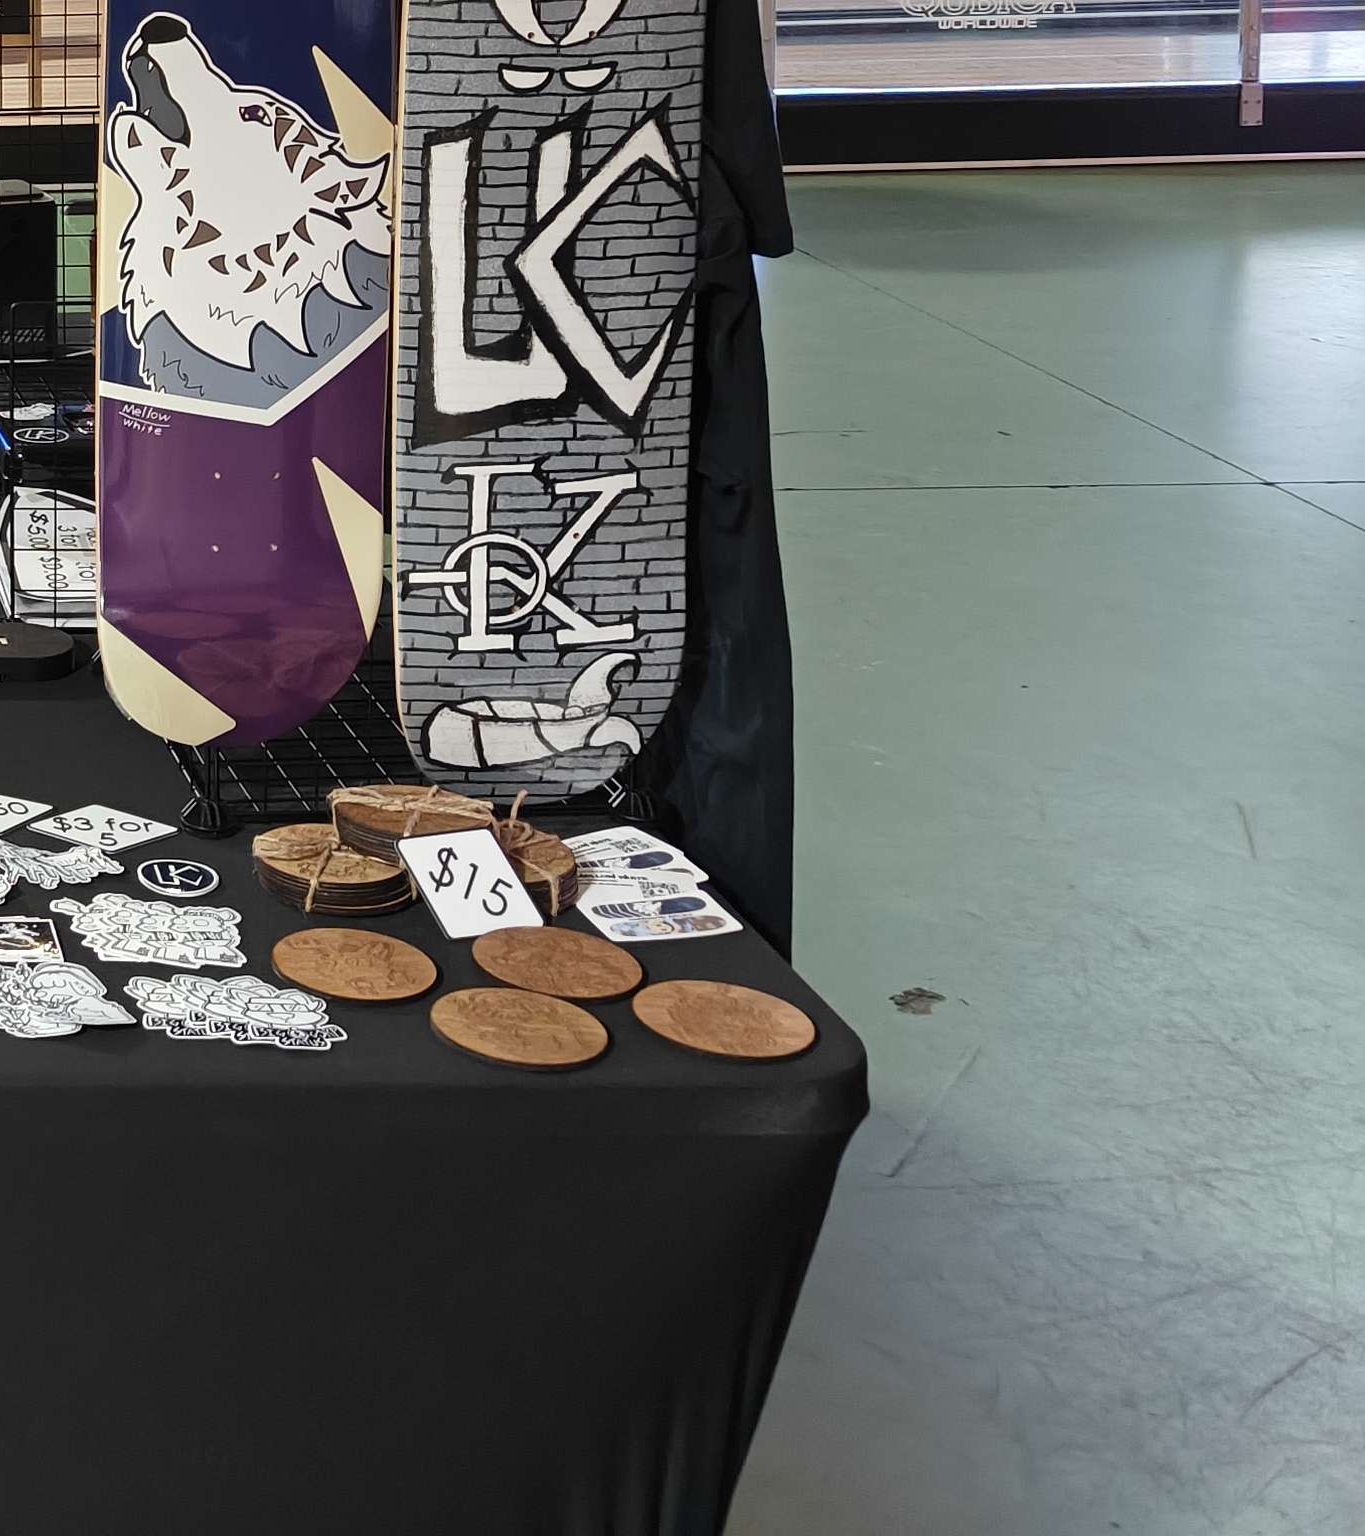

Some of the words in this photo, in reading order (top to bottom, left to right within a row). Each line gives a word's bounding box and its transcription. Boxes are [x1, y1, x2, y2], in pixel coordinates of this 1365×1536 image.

[938, 18, 1038, 30] WORLDWIDE
[122, 404, 172, 421] Mellow
[28, 510, 51, 549] $5.00
[52, 816, 94, 832] $3
[105, 817, 155, 832] for
[99, 832, 118, 847] 5
[428, 846, 514, 917] $15
